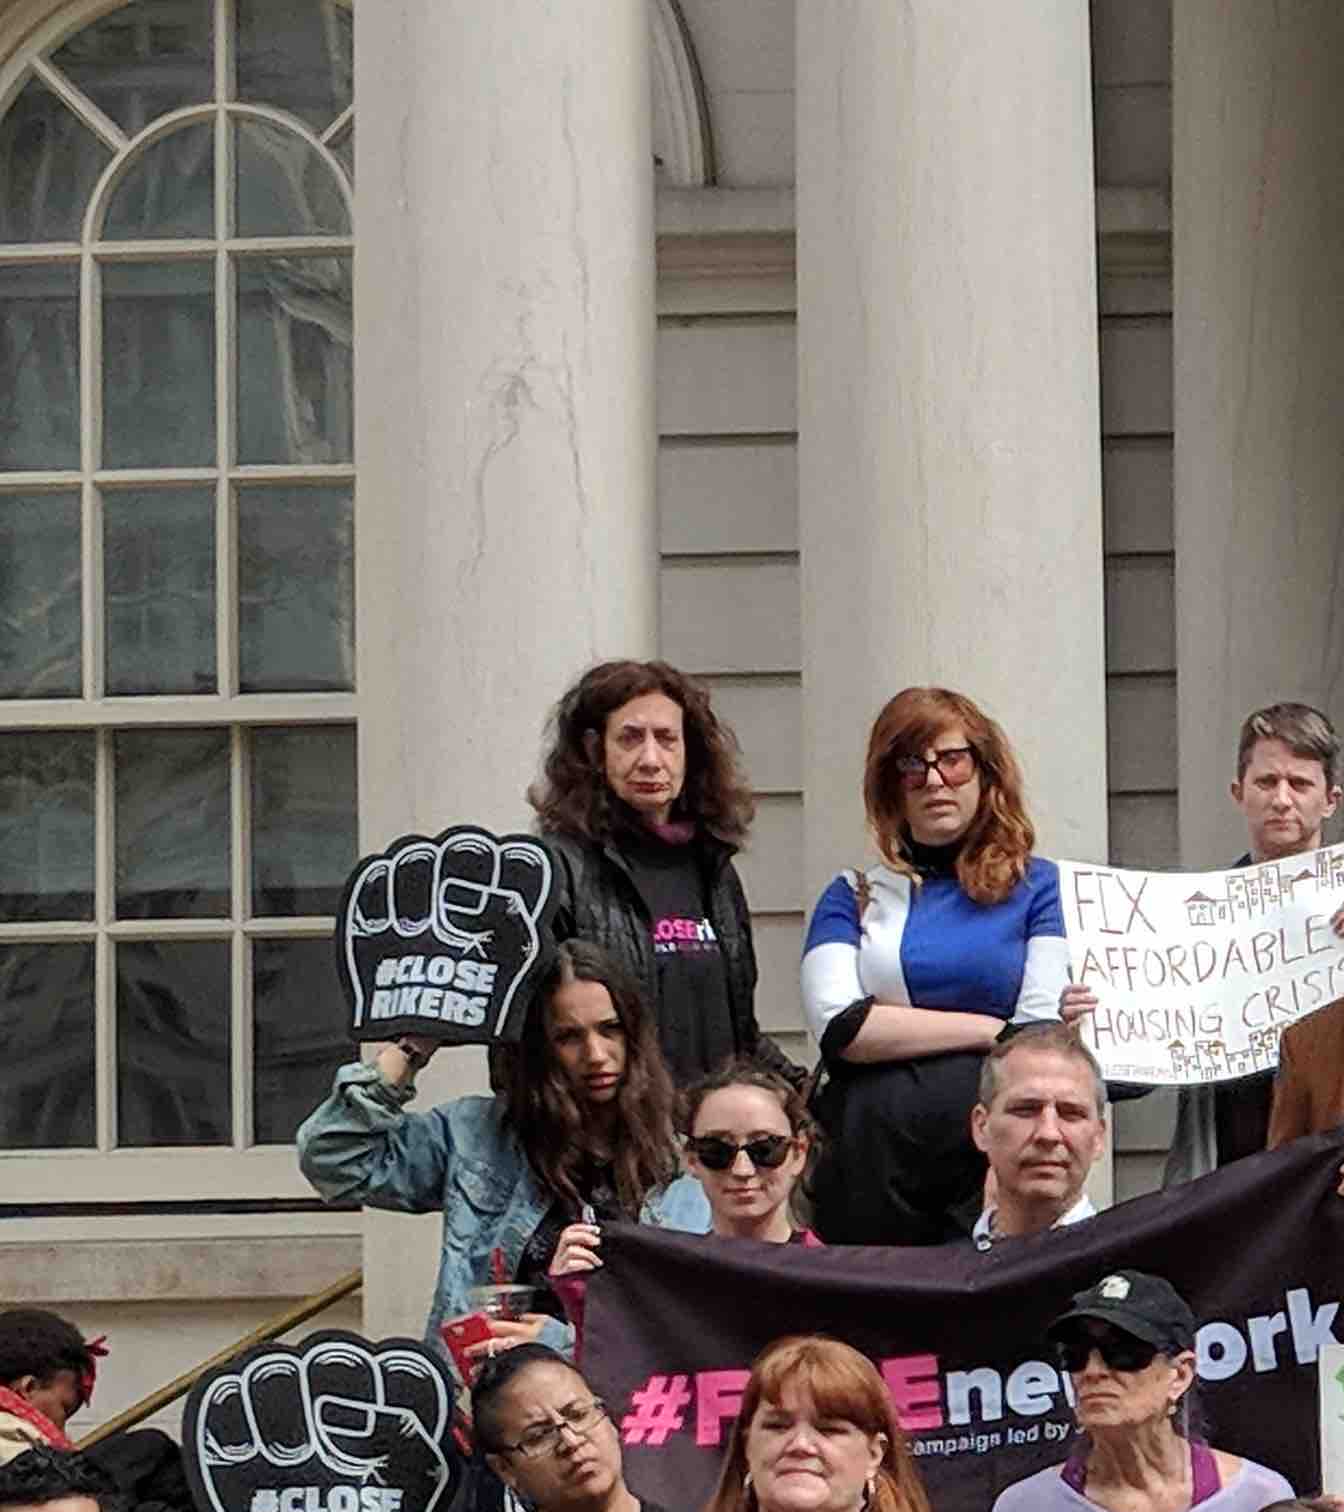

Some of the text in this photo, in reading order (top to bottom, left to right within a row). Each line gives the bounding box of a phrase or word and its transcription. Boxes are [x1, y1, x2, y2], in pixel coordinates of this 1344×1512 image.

[1071, 870, 1156, 936] FIX
[375, 955, 499, 994] #CLOSE
[1079, 913, 1336, 992] AFFORDABLE
[370, 986, 489, 1027] RIKERS
[1090, 999, 1223, 1051] HOUSING
[1008, 1424, 1039, 1444] led
[1044, 1421, 1070, 1442] by
